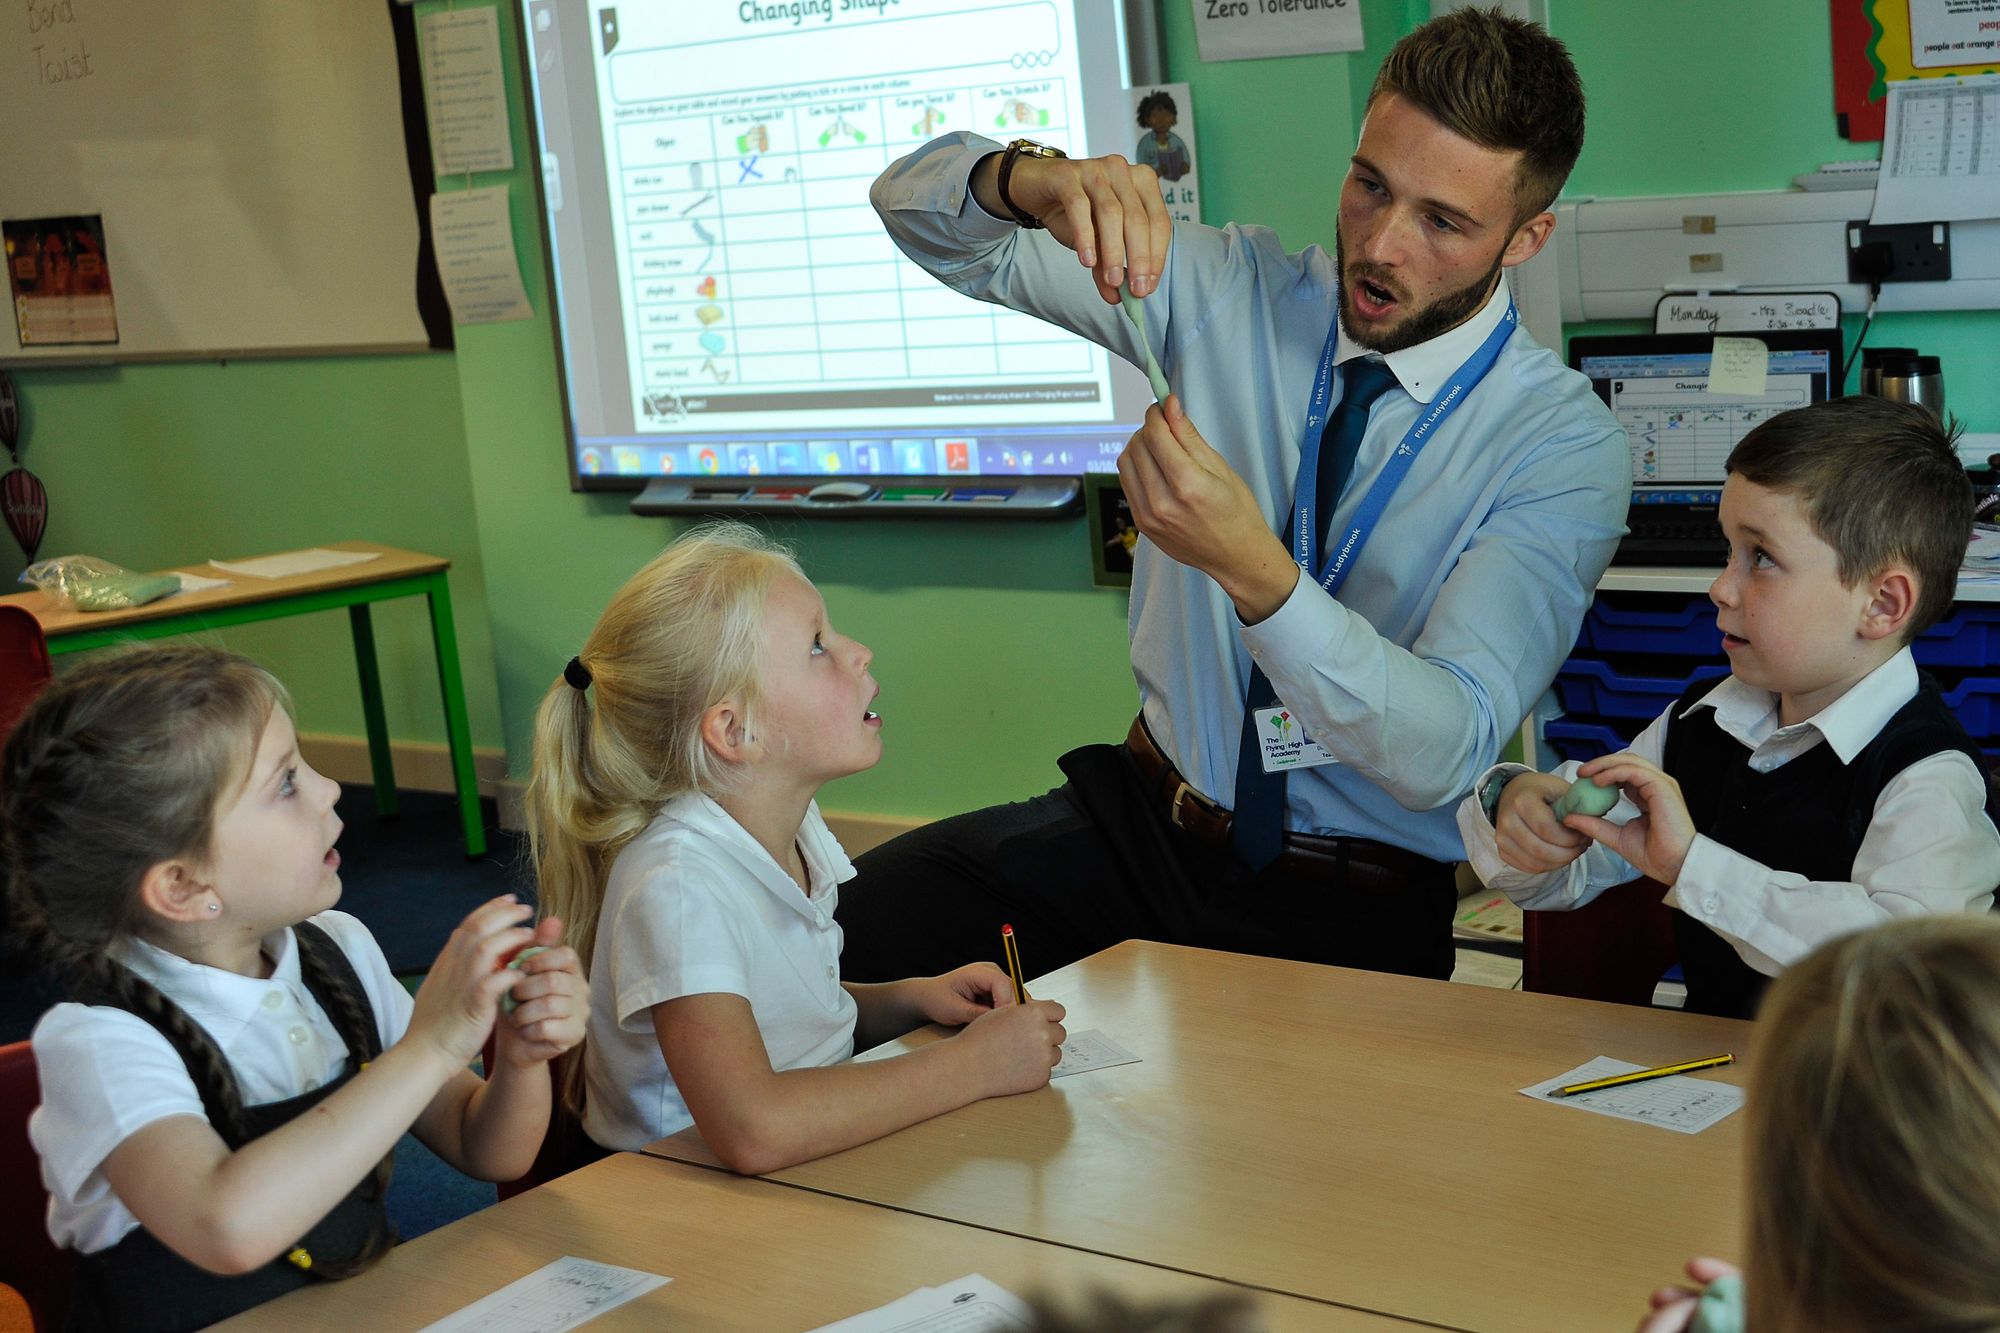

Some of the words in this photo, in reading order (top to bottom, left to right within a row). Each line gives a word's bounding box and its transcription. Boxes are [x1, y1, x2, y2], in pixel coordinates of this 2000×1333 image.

[739, 0, 832, 26] Changing
[1204, 0, 1248, 19] Zero
[1924, 42, 1950, 54] people
[1951, 41, 1965, 49] eat
[1967, 41, 1995, 49] orange
[32, 40, 94, 85] Twist
[1181, 188, 1194, 204] it
[1670, 301, 1720, 332] Monday
[1759, 304, 1776, 316] Mrs
[1315, 387, 1324, 405] FHA
[1414, 423, 1430, 439] FHA
[1427, 384, 1462, 422] Ladybrook
[1300, 507, 1309, 557] Ladybrook
[1322, 574, 1336, 591] FHA
[1332, 528, 1361, 573] Ladybrook
[1265, 744, 1285, 752] Flying
[1271, 750, 1301, 758] Academy
